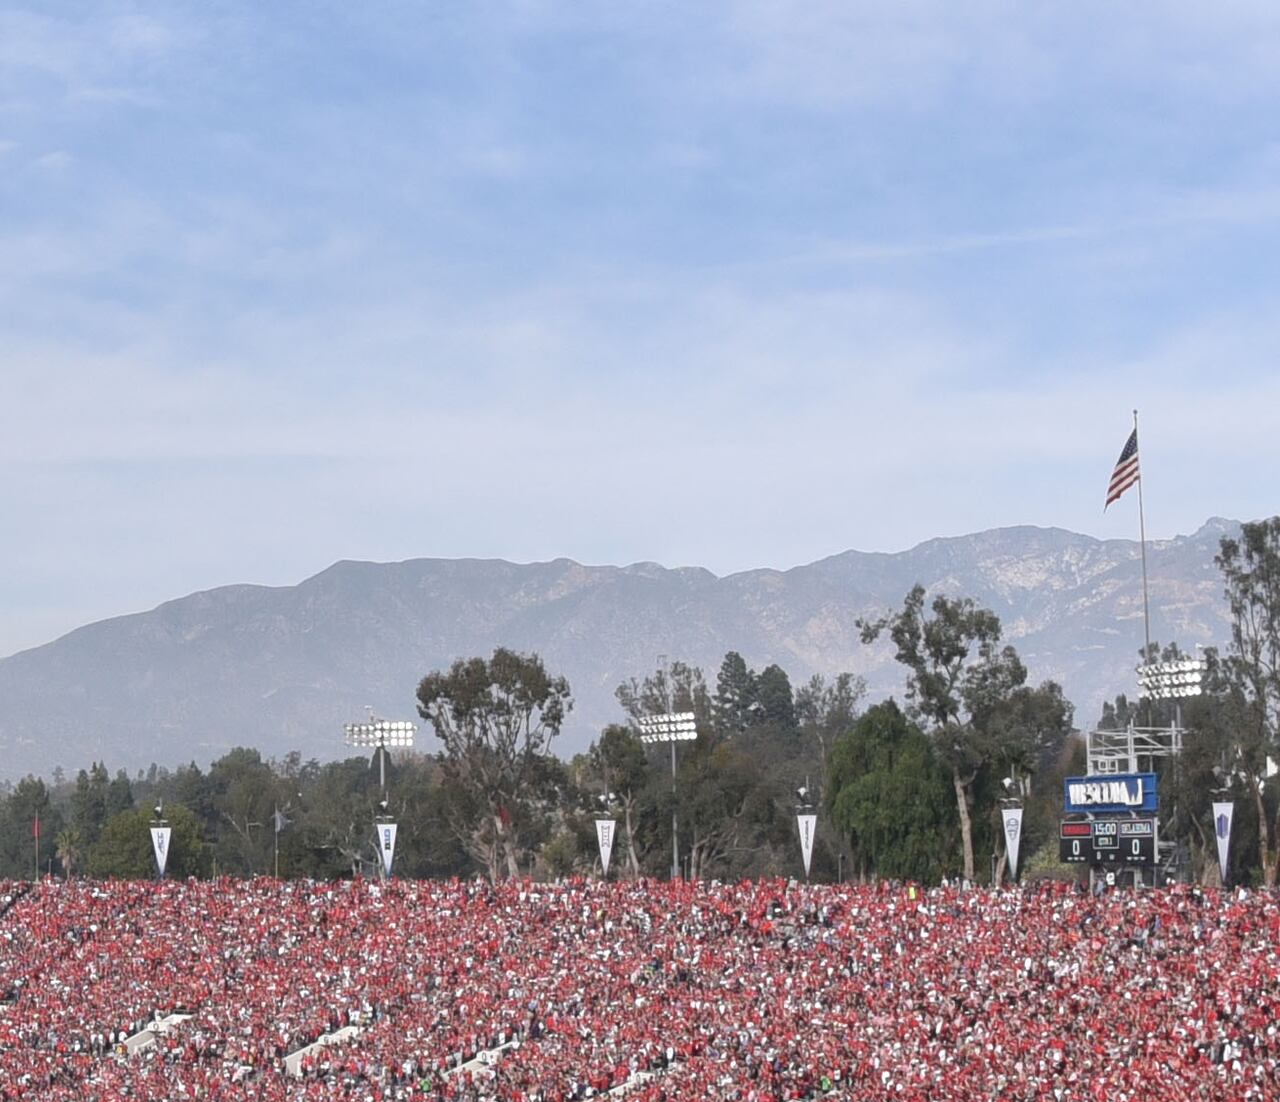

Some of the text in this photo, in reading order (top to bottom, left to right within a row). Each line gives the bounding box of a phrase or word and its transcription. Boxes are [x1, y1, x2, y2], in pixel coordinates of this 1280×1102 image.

[1095, 823, 1116, 836] 15:00
[1072, 840, 1080, 856] 0
[1132, 839, 1140, 855] 0
